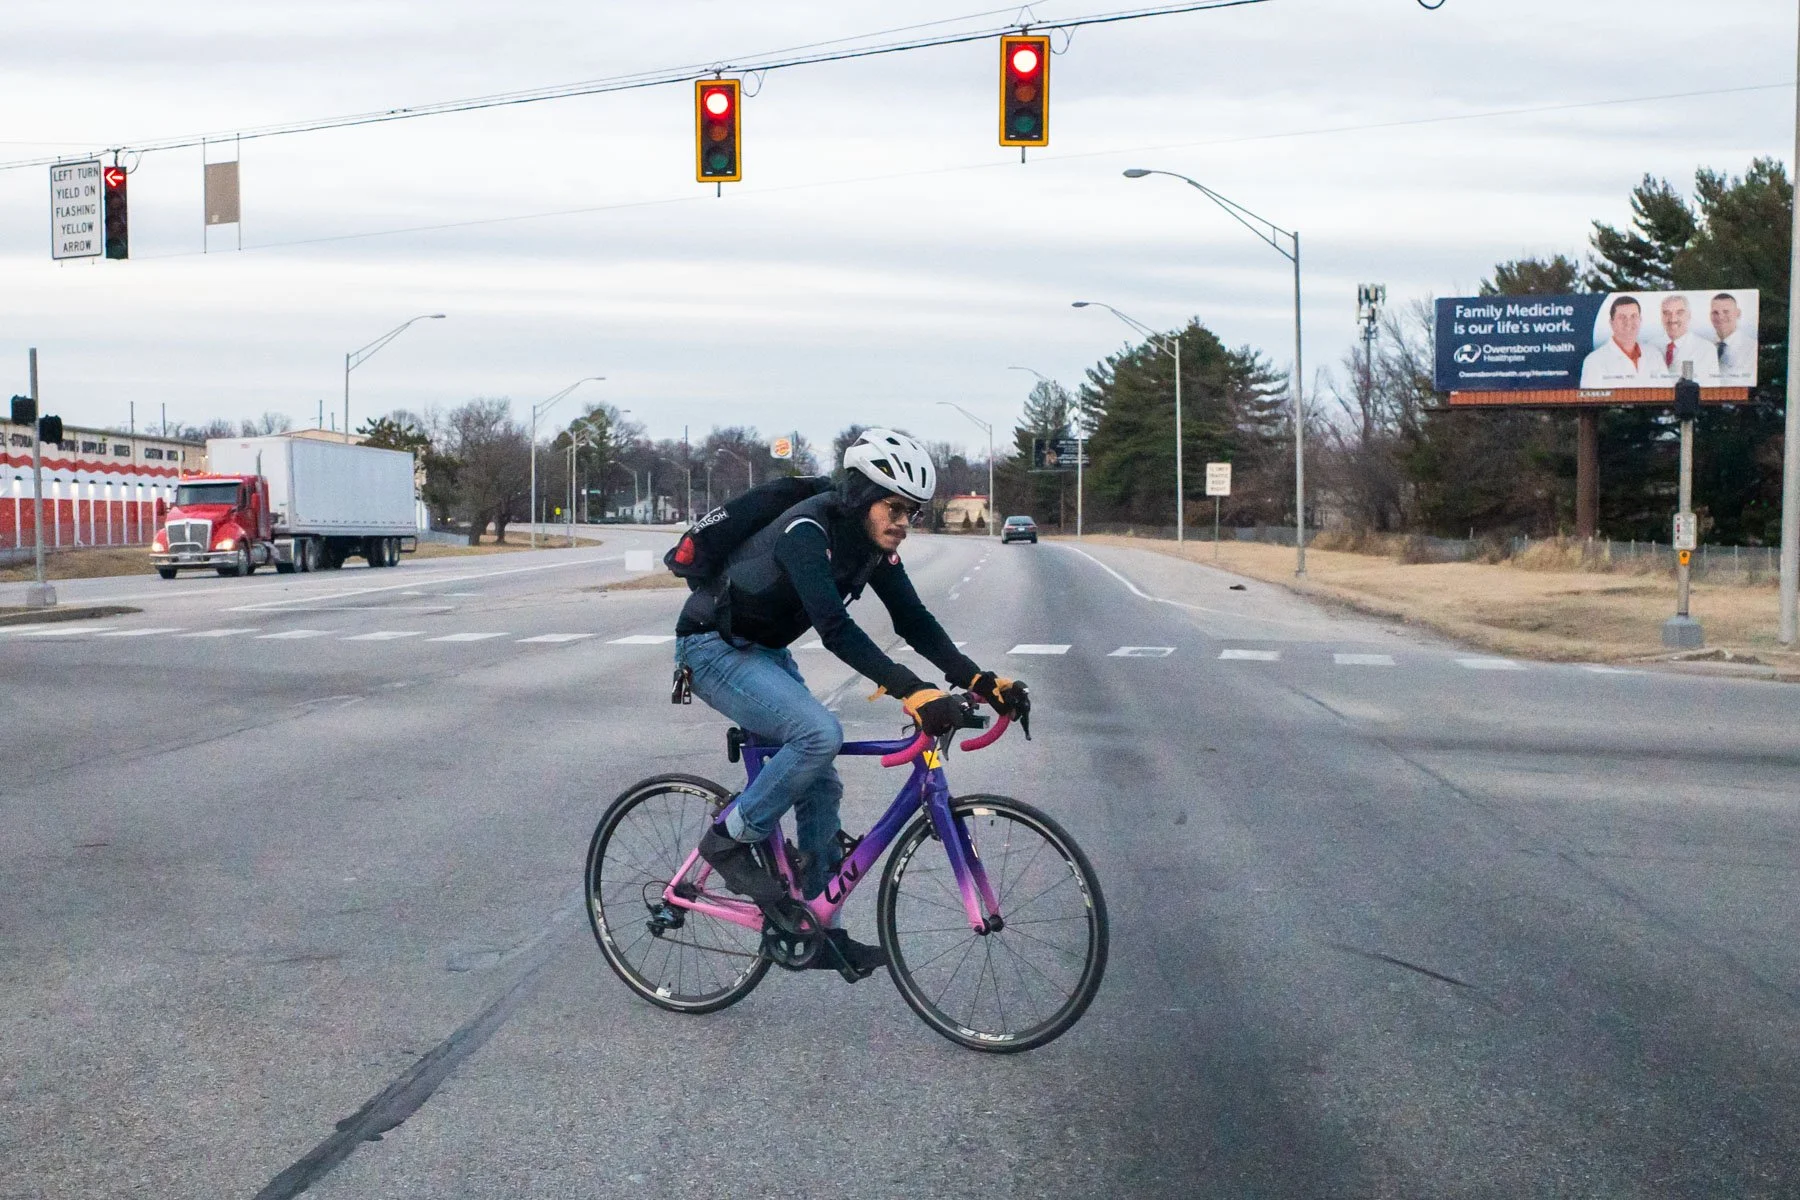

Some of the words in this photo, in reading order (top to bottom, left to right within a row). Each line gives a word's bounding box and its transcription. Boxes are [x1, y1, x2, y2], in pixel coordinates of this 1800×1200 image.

[53, 169, 73, 182] LEFT
[77, 167, 99, 179] TURN
[56, 187, 80, 199] YIELD
[84, 186, 96, 197] ON
[56, 204, 96, 218] FLASHING
[61, 222, 94, 235] YELLOW
[62, 240, 92, 253] ARROW
[1455, 304, 1503, 321] Family
[1506, 302, 1574, 317] Medicine
[1453, 321, 1466, 335] is
[1467, 323, 1494, 335] our
[1497, 320, 1530, 334] life's
[1532, 319, 1575, 333] work.
[1482, 343, 1541, 354] Owensboro
[1542, 342, 1575, 353] Health
